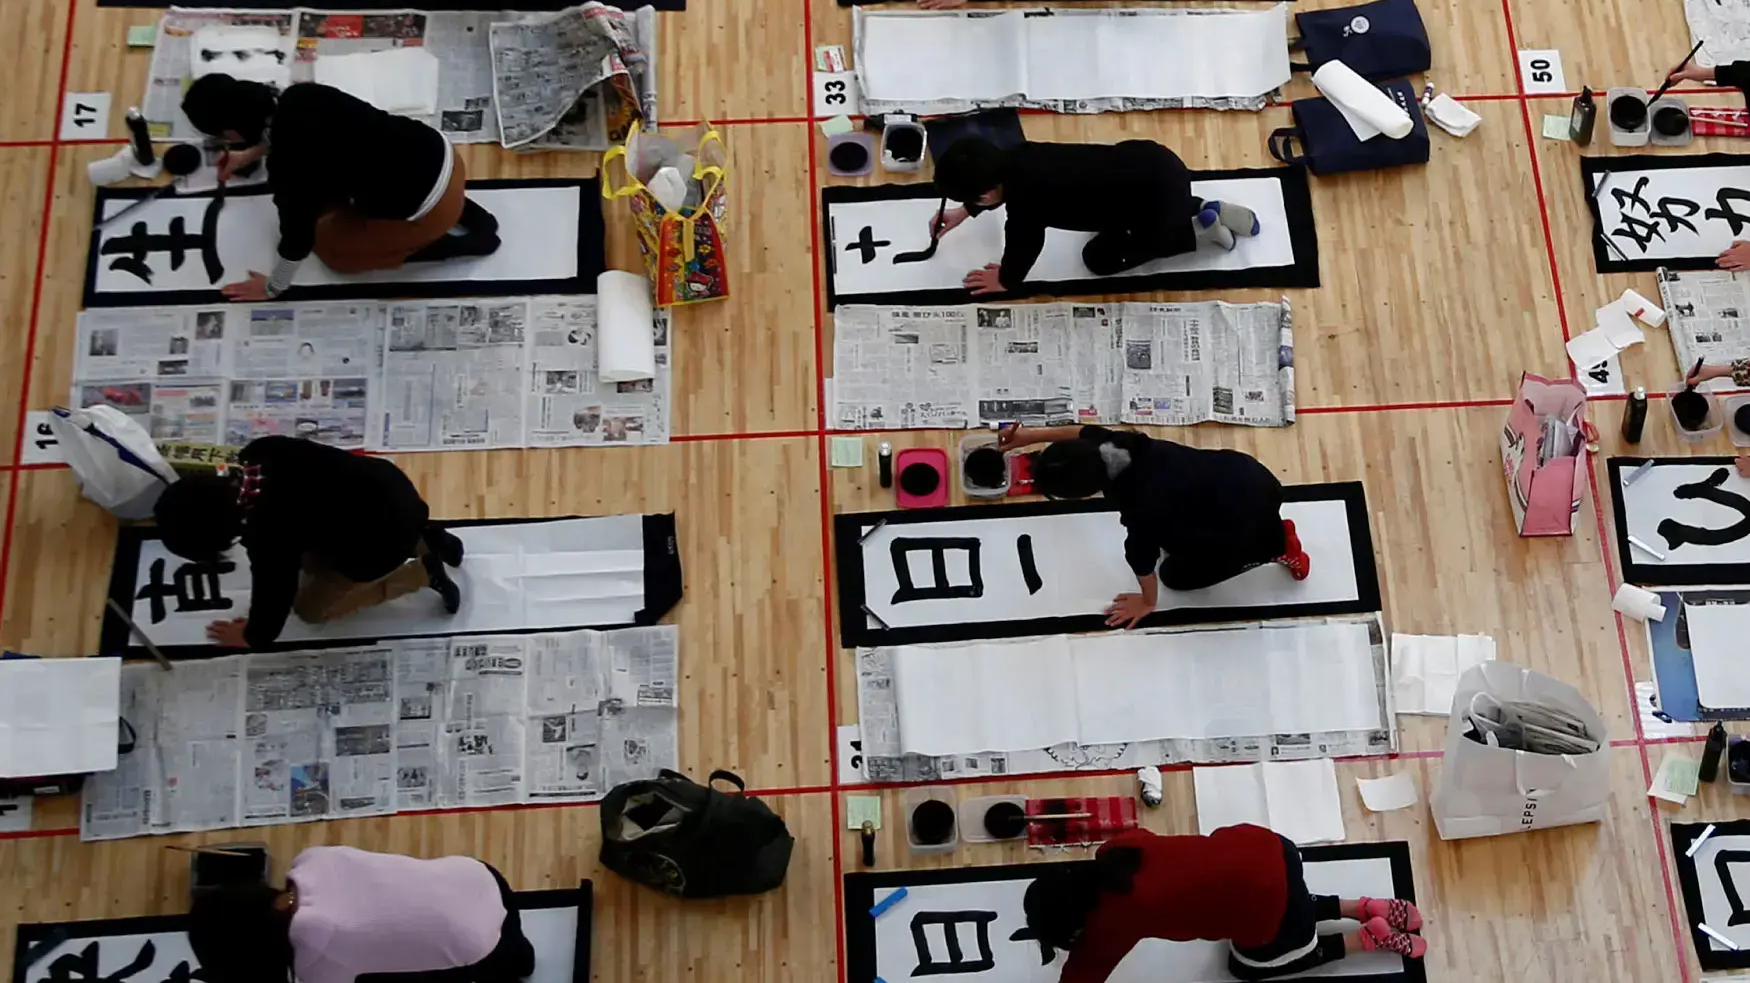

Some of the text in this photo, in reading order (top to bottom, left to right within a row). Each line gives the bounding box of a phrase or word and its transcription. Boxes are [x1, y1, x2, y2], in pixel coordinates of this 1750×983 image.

[1530, 58, 1552, 83] 50
[825, 80, 846, 105] 33
[73, 103, 97, 128] 17
[100, 207, 224, 285] 生
